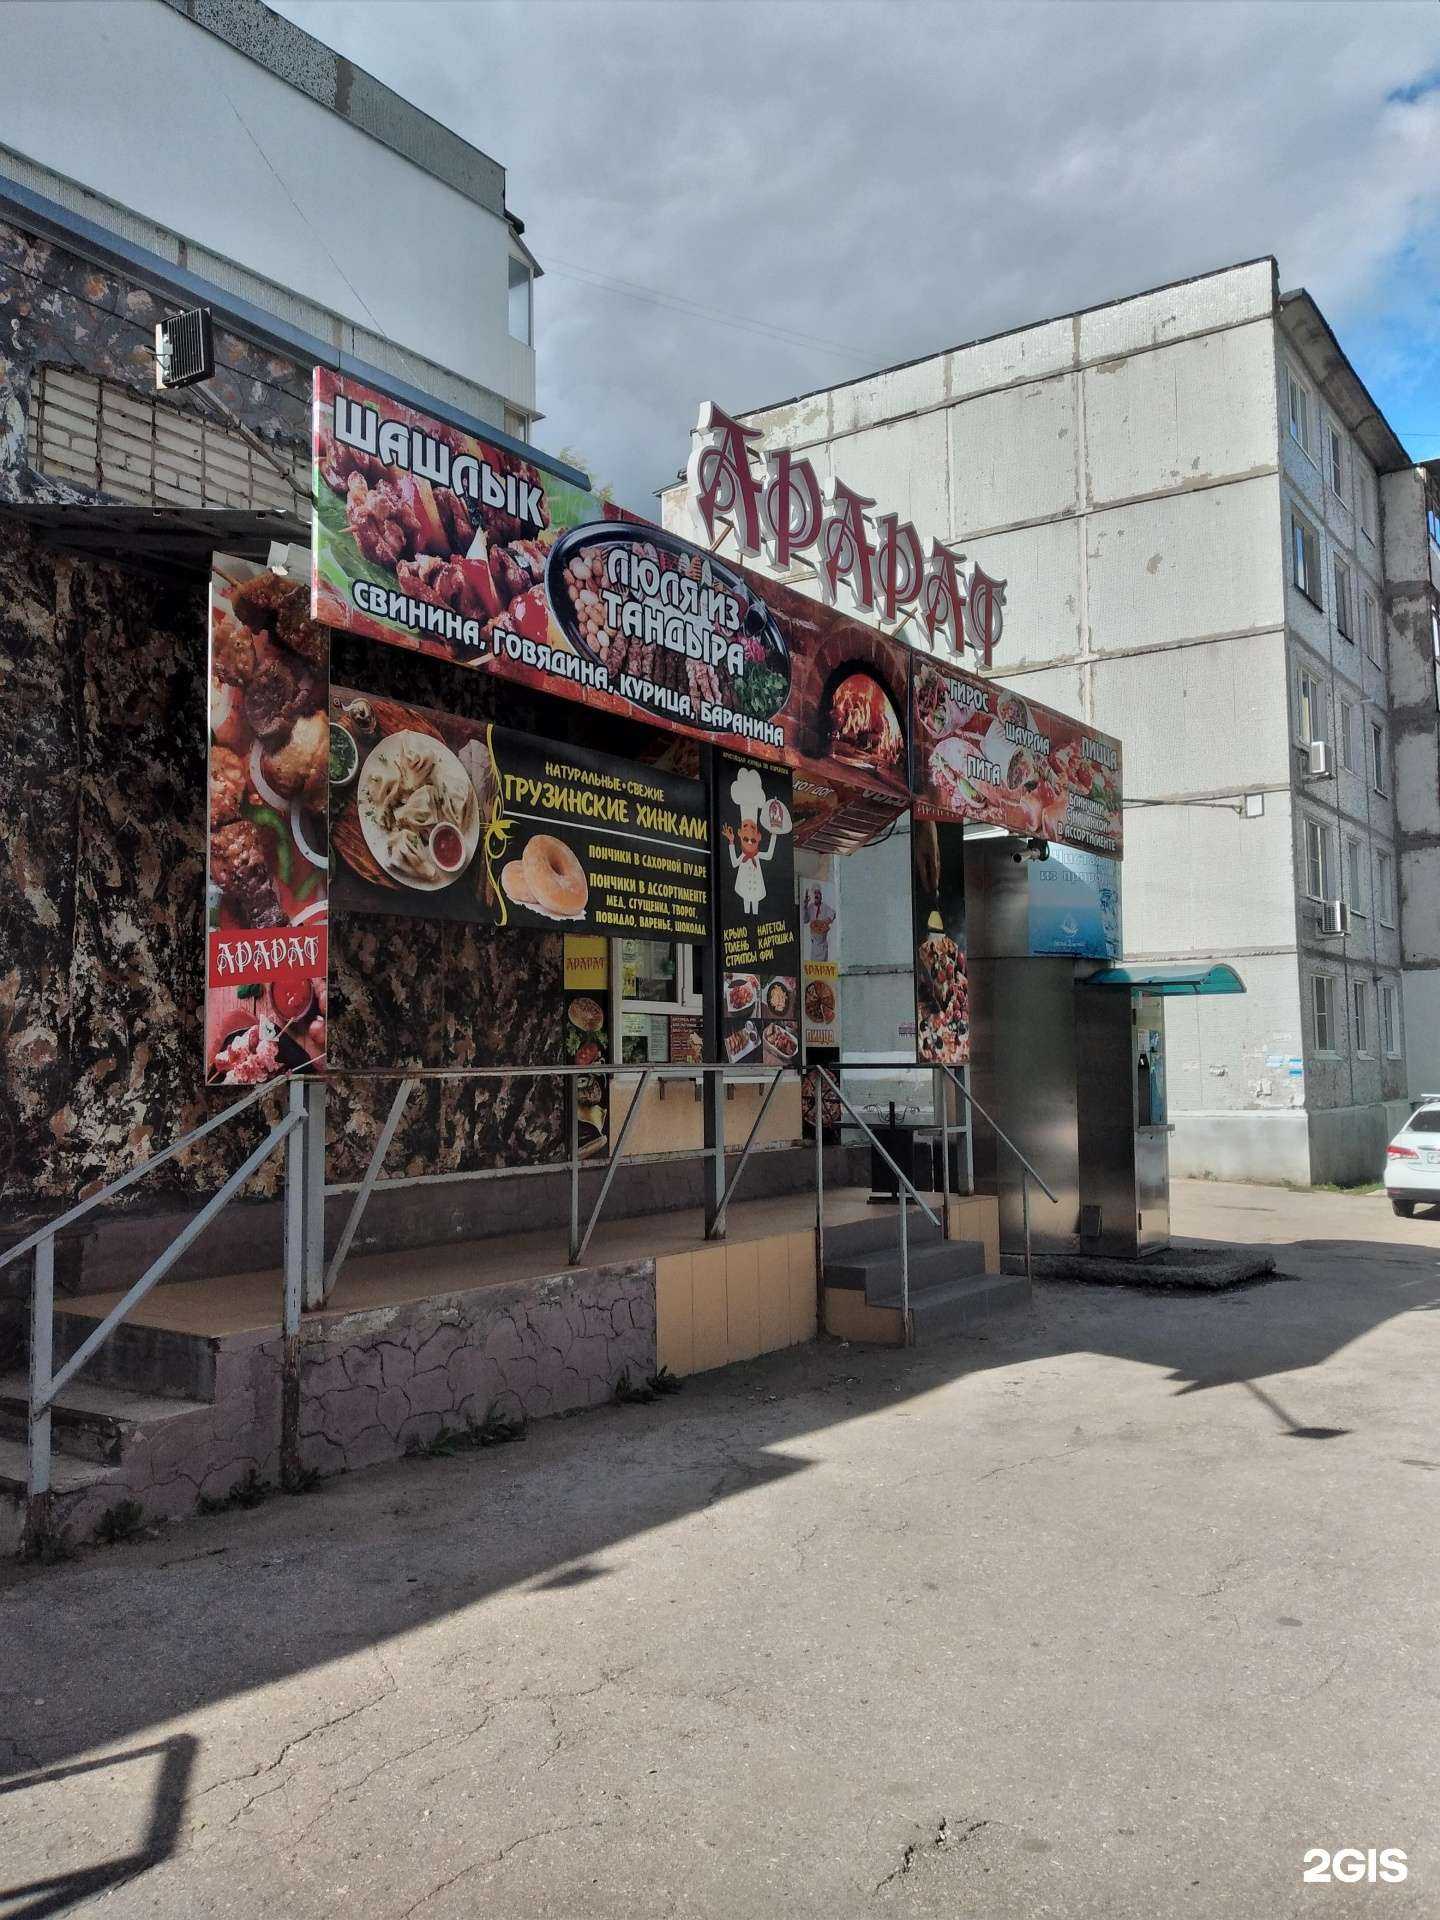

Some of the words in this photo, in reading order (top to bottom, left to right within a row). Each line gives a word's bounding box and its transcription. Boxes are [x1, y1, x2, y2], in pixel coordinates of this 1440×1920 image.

[333, 395, 546, 529] ШАШЛЫК
[688, 401, 1008, 671] АРАРАТ
[608, 549, 702, 614] ЛЮЛЯ
[707, 594, 741, 631] ИЗ
[602, 590, 745, 676] ТАНДЫРА
[353, 580, 486, 650] СВИНИНА,
[494, 630, 613, 694] ГОВЯДИНА,
[620, 676, 695, 721] КУРИЦА,
[701, 698, 784, 747] БАРАНИНА
[950, 678, 989, 713] ГИРОС
[1005, 721, 1051, 755] ШАУРМА
[1082, 736, 1117, 770] ПИЦЦА
[545, 761, 621, 792] НАТУРАЛЬНЫЕ
[627, 781, 665, 802] СВЕЖИЕ
[967, 754, 1001, 786] ПИТА
[503, 774, 629, 823] ГРУЗИНСКИЕ
[635, 803, 709, 842] ХИНКАЛИ
[1064, 821, 1116, 851] АССОРТИМЕНТЕ
[588, 844, 632, 864] ПОНЧИКИ
[634, 853, 640, 866] В
[683, 863, 707, 878] ПУДРЕ
[589, 873, 636, 892] ПОНЧИКИ
[639, 880, 645, 894] В
[648, 881, 707, 904] АССОРТИМЕНТЕ
[216, 936, 319, 976] АРАРАТ
[758, 931, 795, 950] КАРТОШКА
[759, 948, 774, 962] ФРИ
